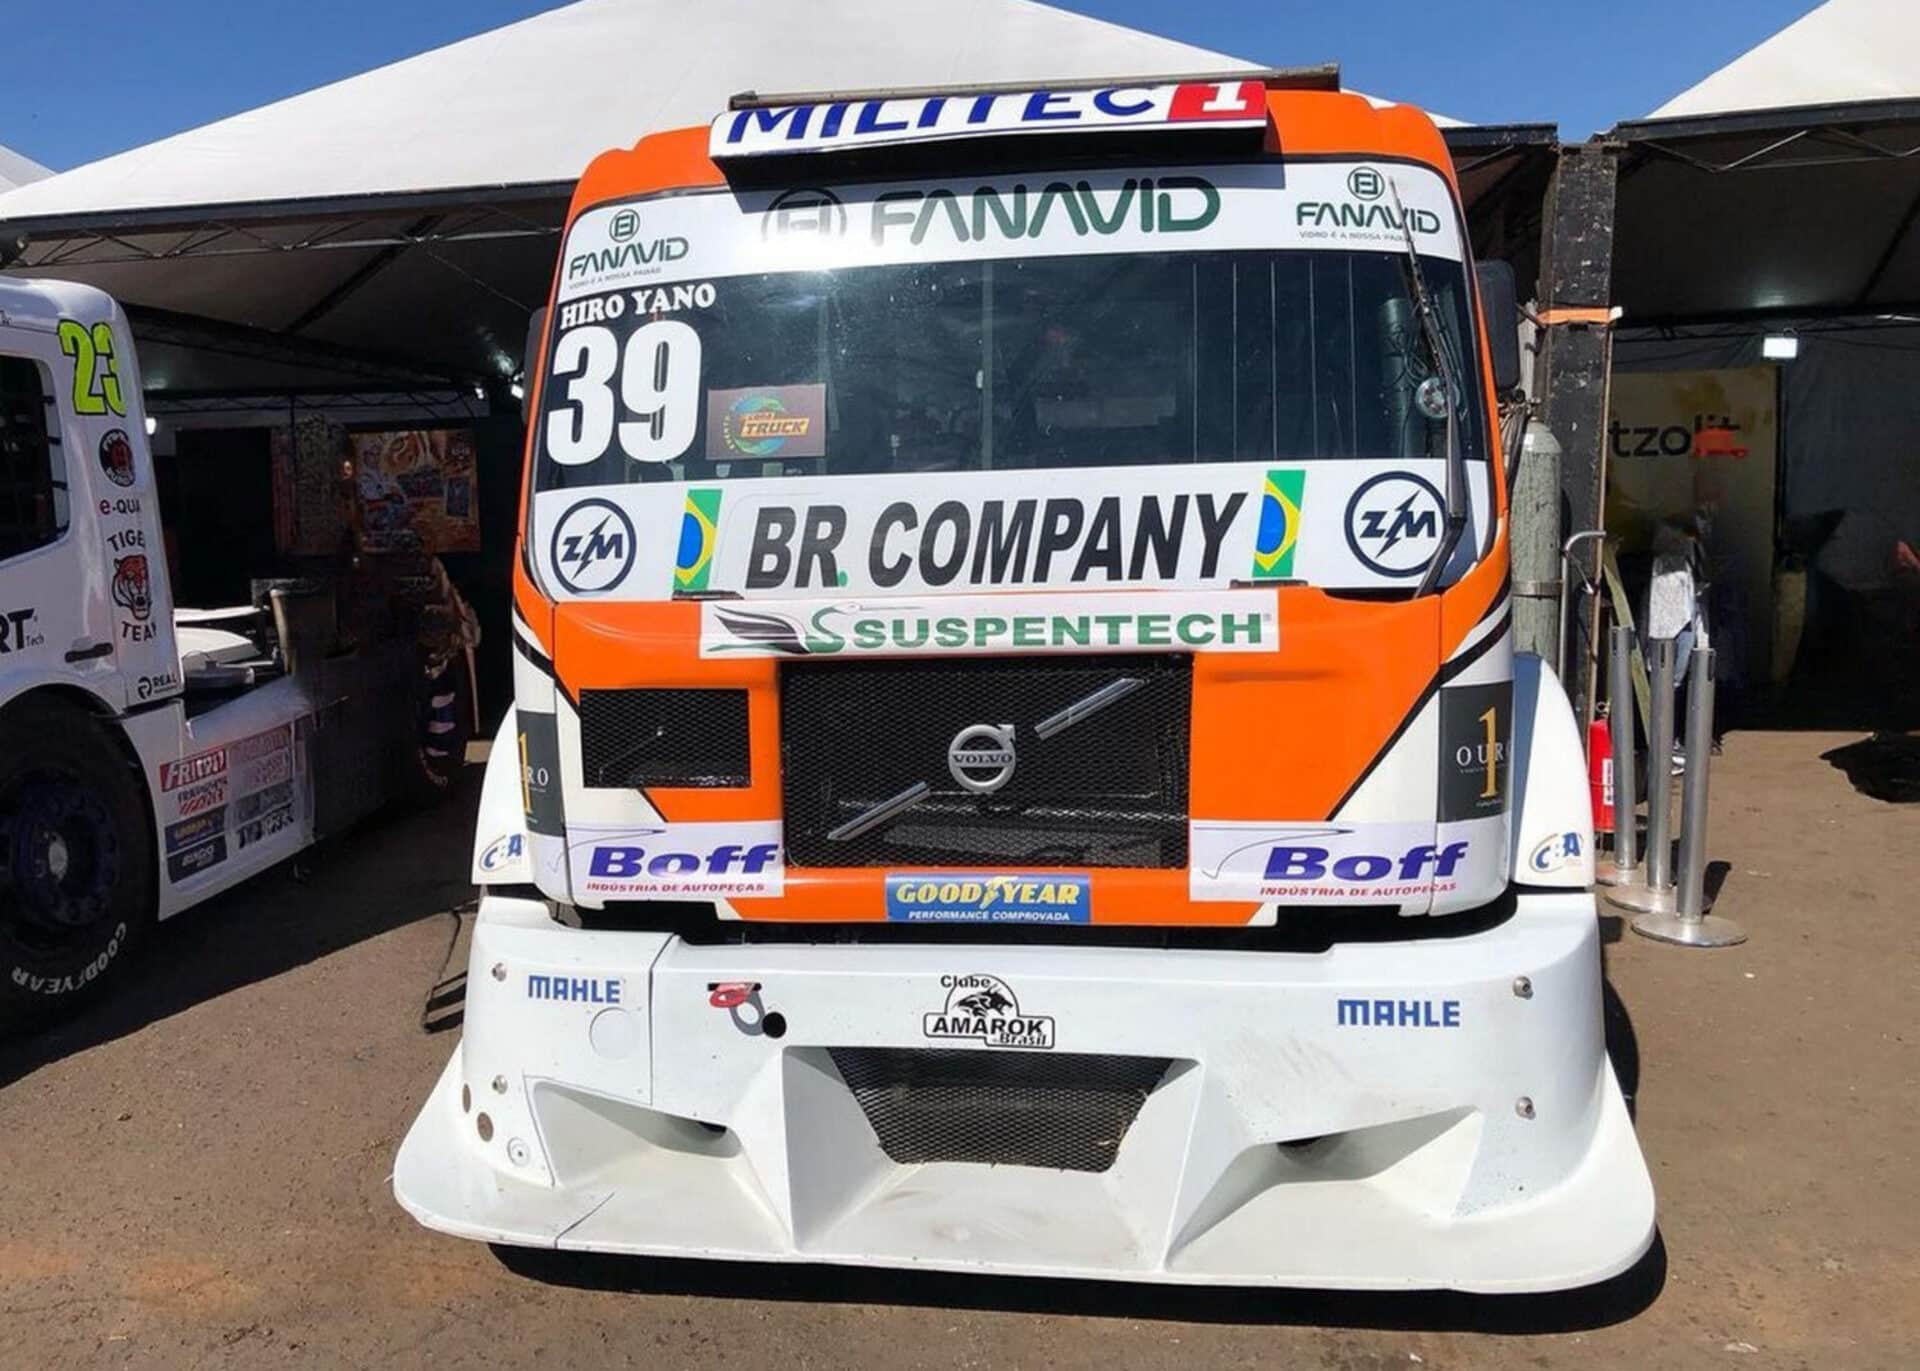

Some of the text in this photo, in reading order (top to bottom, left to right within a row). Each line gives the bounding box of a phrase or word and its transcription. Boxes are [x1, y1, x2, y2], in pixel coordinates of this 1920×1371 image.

[1202, 81, 1247, 112] 1
[871, 177, 1221, 246] FANAVID
[1297, 202, 1441, 234] FANAVID
[569, 237, 689, 280] FANAVID
[560, 283, 716, 329] HIRO YANO
[57, 319, 126, 417] 23
[547, 320, 701, 465] 39
[746, 419, 806, 434] TRUCK
[868, 492, 1249, 588] COMPANY
[853, 613, 1262, 649] SUSPENTECH
[953, 753, 1013, 765] VOLVO
[589, 844, 778, 878] Boff
[1263, 841, 1469, 881] Boff
[587, 882, 765, 893] INDÚSTRIA DE AUTOPEÇAS
[1259, 885, 1345, 896] INDÚSTRIA
[1350, 887, 1369, 896] DE
[909, 910, 1070, 921] PERFORMANCE COMPROVADA
[528, 975, 620, 1004] MAHLE
[932, 1016, 1045, 1036] AMAROK
[1338, 999, 1460, 1027] MAHLE
[1000, 1032, 1047, 1046] Brasil
